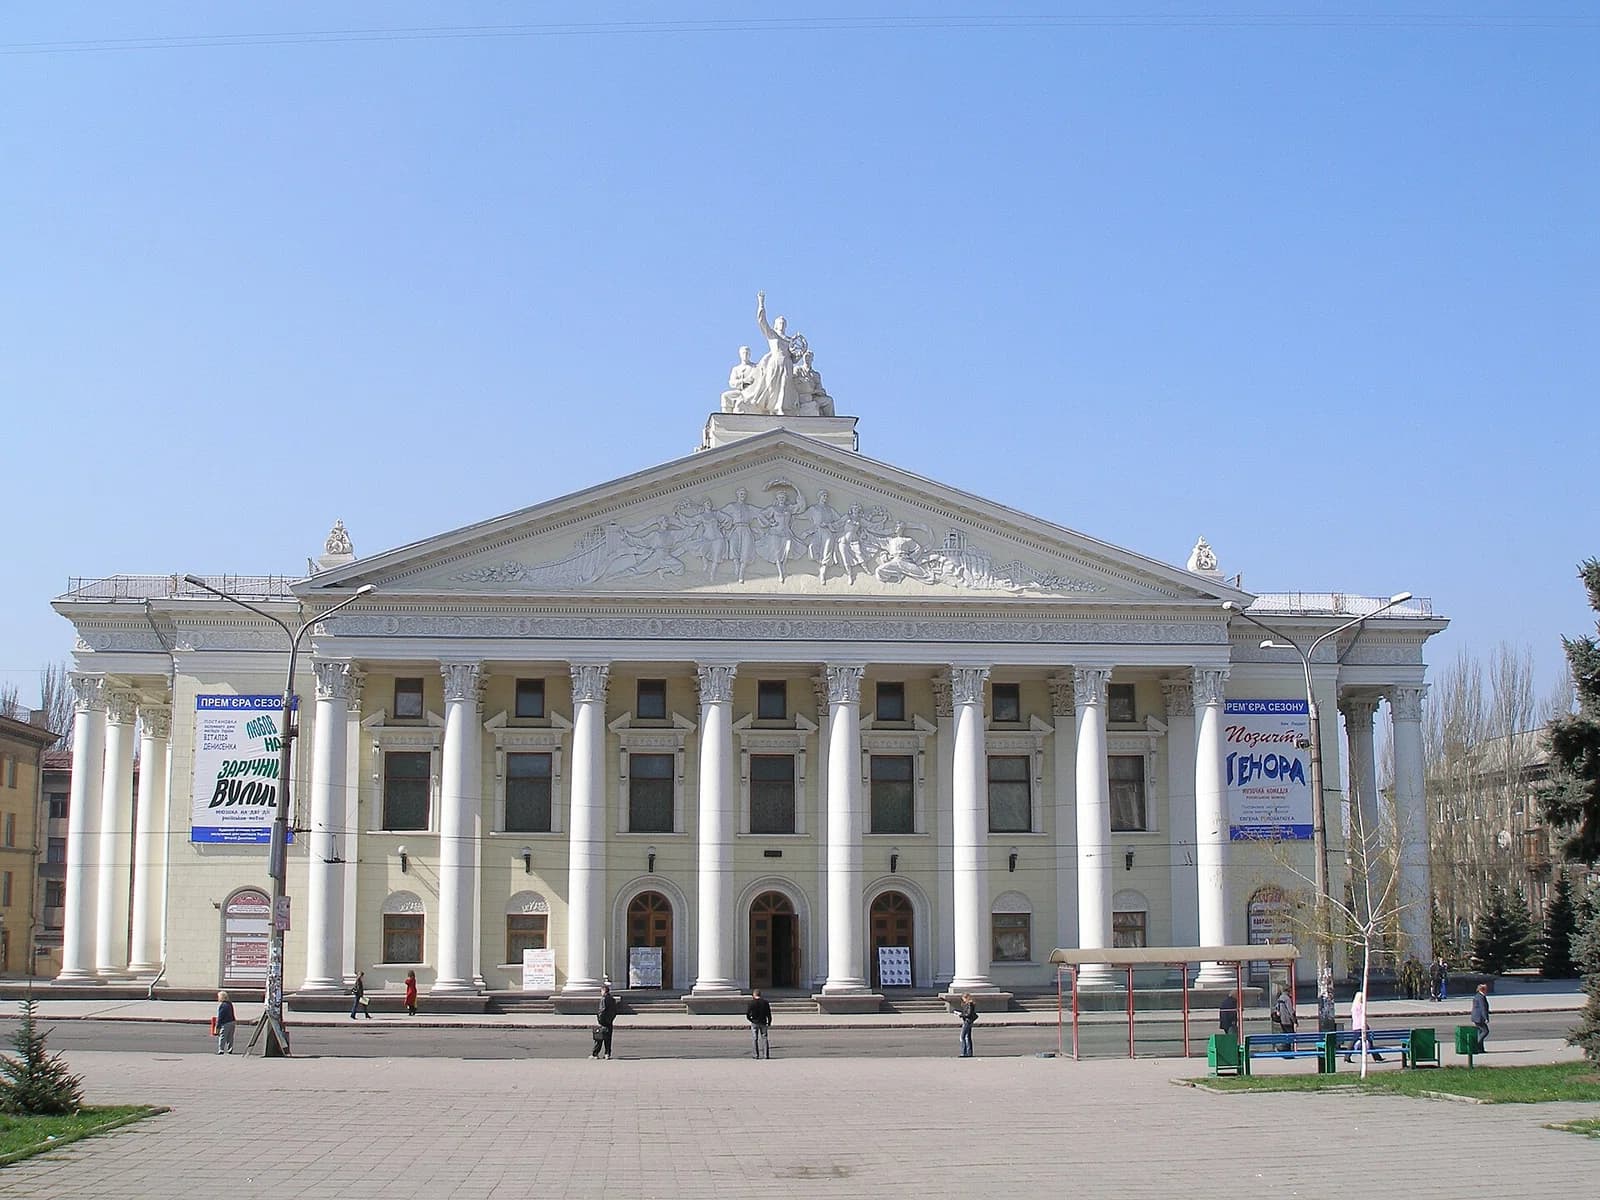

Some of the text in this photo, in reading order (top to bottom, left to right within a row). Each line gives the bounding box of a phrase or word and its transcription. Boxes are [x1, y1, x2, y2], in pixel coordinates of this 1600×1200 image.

[254, 698, 284, 707] СЕЗО
[1225, 702, 1304, 711] РЕМ'ЄРА СЕЗОНУ
[246, 715, 278, 740] ЛЮБОВ
[264, 737, 282, 752] НА
[208, 779, 278, 808] ВУЛИ
